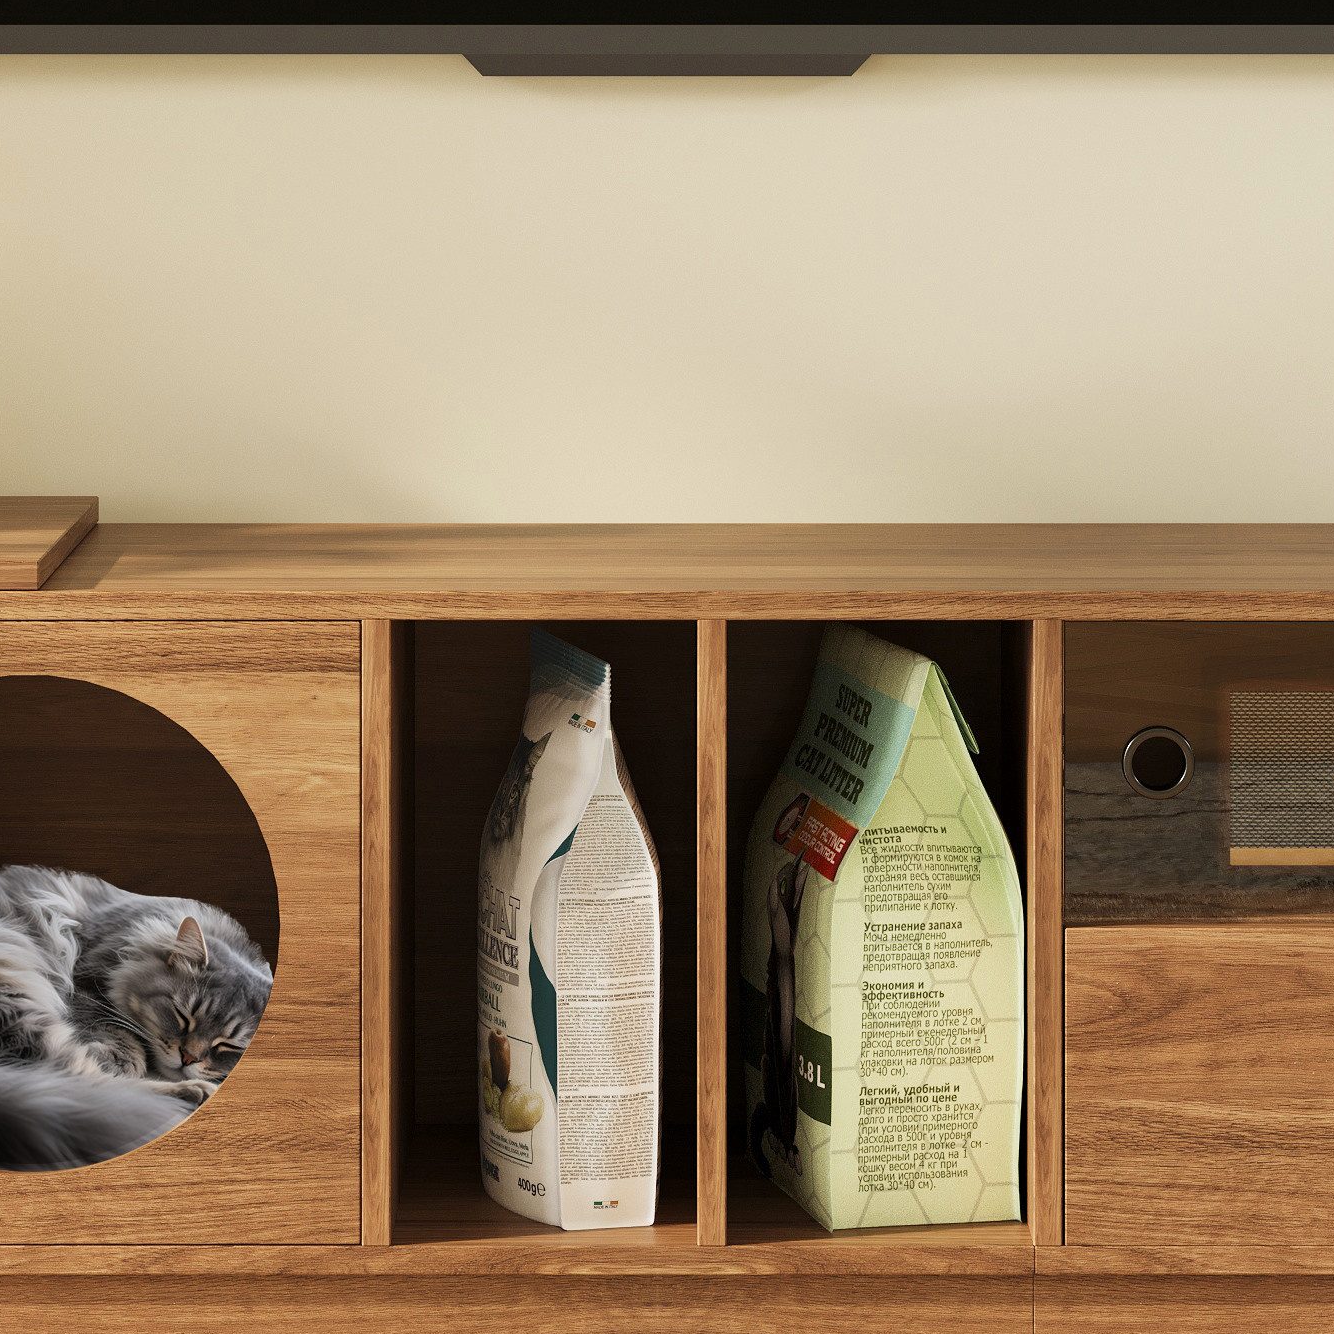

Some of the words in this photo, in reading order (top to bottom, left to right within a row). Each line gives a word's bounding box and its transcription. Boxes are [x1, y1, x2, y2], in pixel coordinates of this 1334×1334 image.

[835, 683, 873, 729] SUPER
[814, 712, 875, 770] PREMIUM
[858, 835, 902, 845] чистота
[860, 845, 877, 855] Все
[880, 844, 924, 854] жидкости
[934, 893, 948, 901] его
[864, 922, 926, 933] Устранение
[928, 921, 963, 931] запаха
[863, 932, 888, 942] Моча
[891, 931, 947, 943] немедленно
[863, 942, 923, 952] впитывается
[933, 949, 981, 960] появление
[862, 962, 922, 973] неприятного
[862, 981, 915, 991] Экономия
[918, 981, 924, 989] и
[861, 990, 945, 1002] эффективность
[861, 1000, 880, 1011] При
[798, 1054, 814, 1083] 3.8
[816, 1064, 826, 1089] L
[903, 1083, 950, 1096] удобный
[953, 1084, 960, 1092] и
[916, 1095, 929, 1103] по
[932, 1094, 958, 1104] цене
